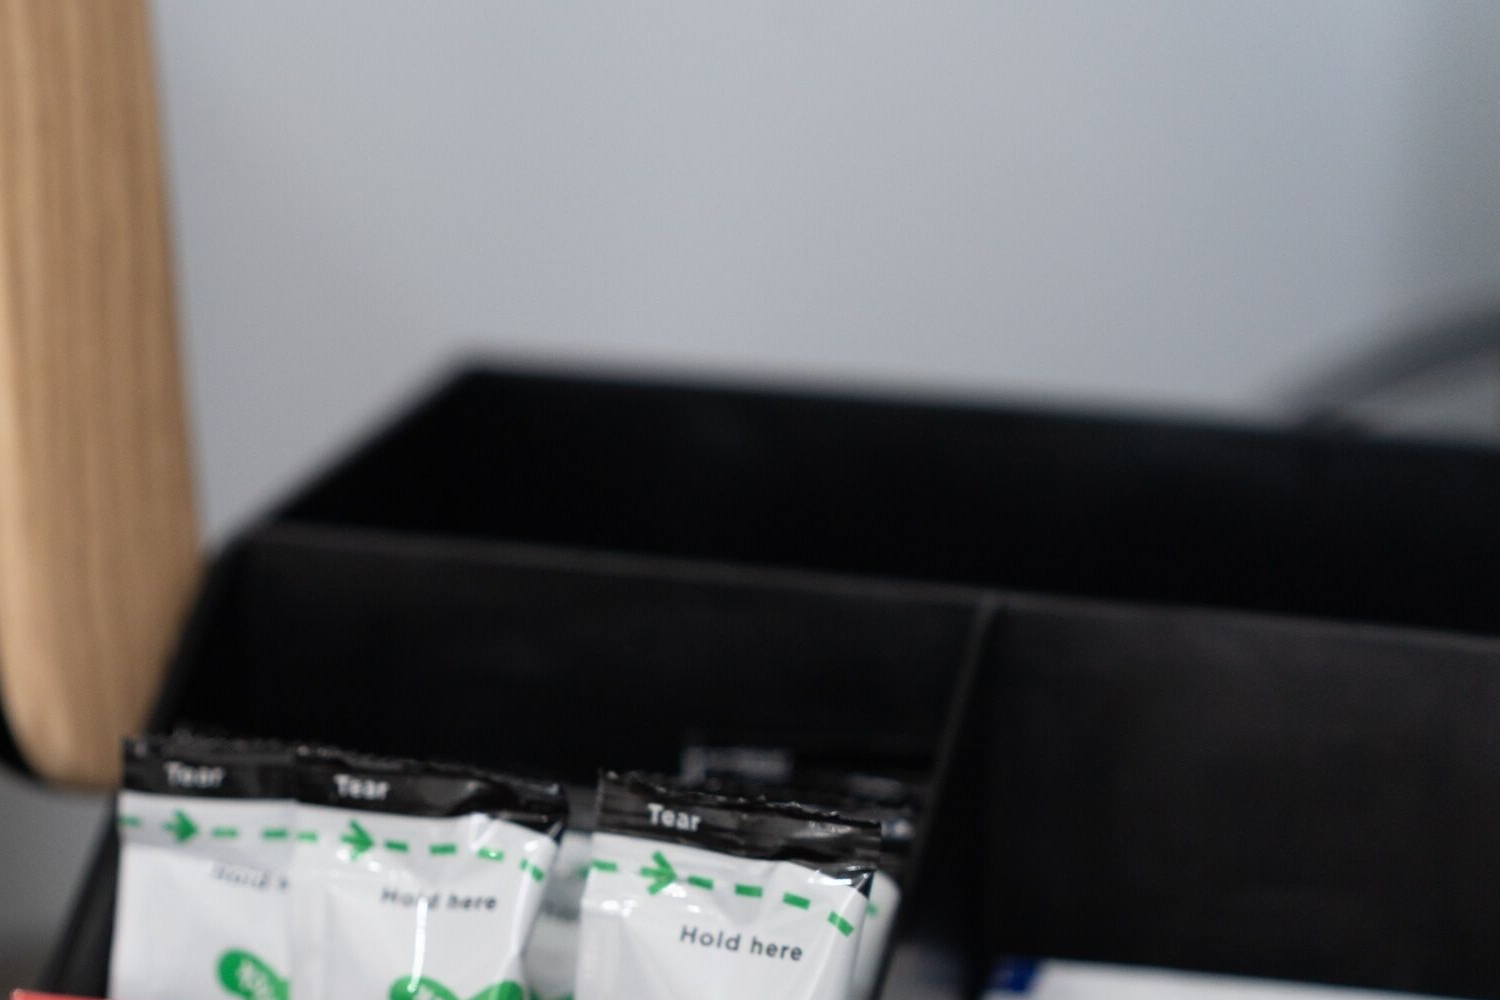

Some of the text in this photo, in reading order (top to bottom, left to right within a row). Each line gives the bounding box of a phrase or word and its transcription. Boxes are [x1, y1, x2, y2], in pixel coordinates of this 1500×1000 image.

[334, 774, 389, 799] Tear
[648, 803, 700, 831] Tear
[680, 925, 803, 961] Hold here
